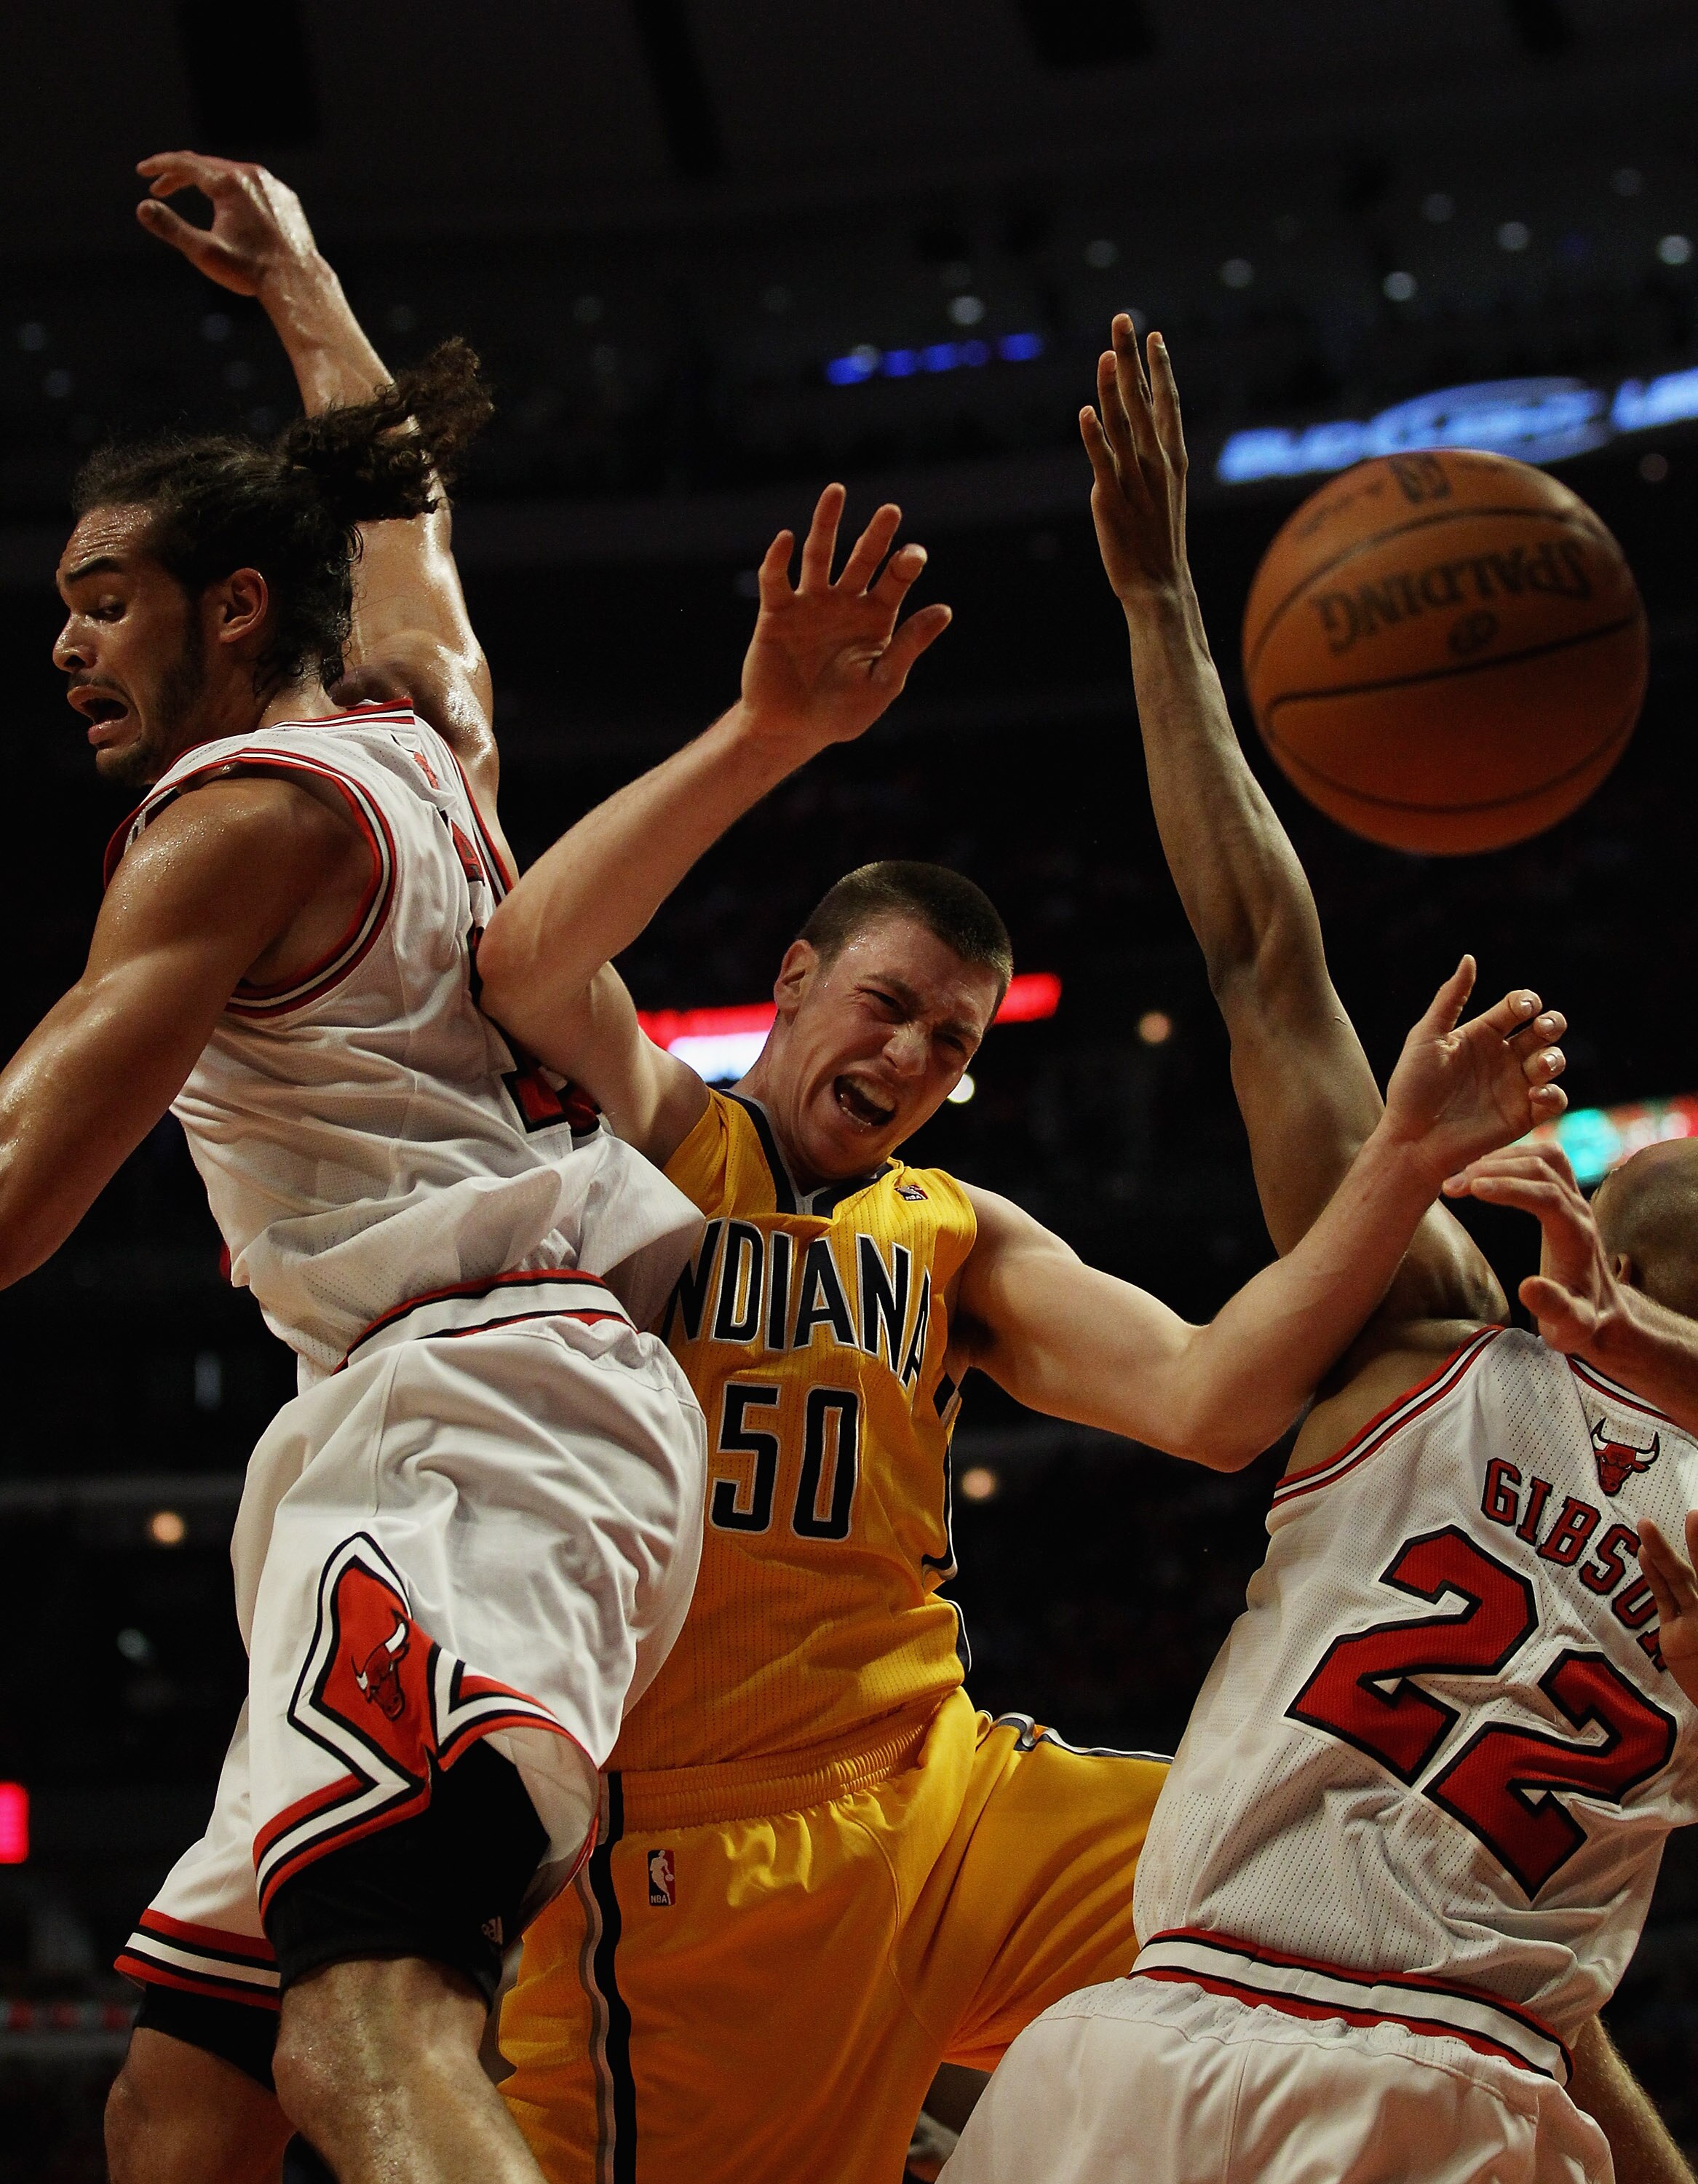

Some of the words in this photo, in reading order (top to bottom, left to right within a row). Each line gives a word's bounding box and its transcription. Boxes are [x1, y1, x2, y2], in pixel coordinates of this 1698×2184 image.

[1315, 540, 1592, 653] SPALDING
[660, 1217, 931, 1391] NDIANA
[709, 1380, 862, 1542] 50
[1481, 1458, 1667, 1672] GIBSO
[1283, 1524, 1677, 1902] 22
[651, 1894, 667, 1904] NBA
